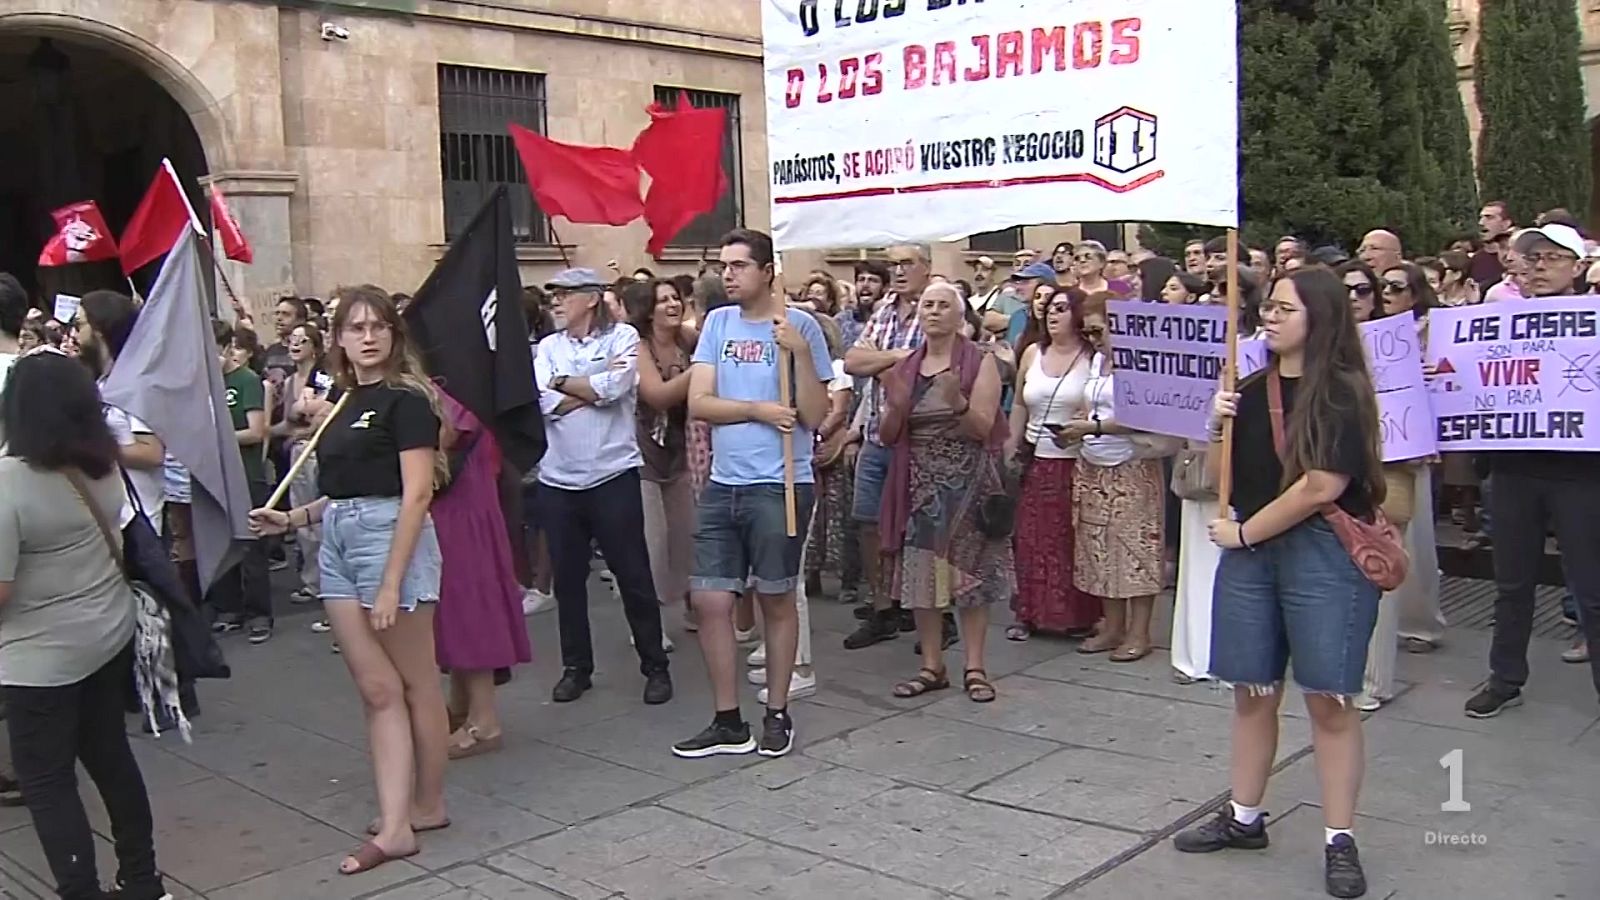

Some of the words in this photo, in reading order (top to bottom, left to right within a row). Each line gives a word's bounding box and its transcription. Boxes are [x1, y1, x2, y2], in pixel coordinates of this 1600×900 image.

[785, 68, 805, 109] O
[816, 52, 883, 104] LOS
[902, 17, 1141, 90] BAJAMOS
[773, 152, 841, 186] PARÁSITOS,
[843, 151, 860, 179] SE
[1002, 128, 1085, 165] NEGOCIO
[1185, 317, 1210, 343] DE
[1453, 315, 1501, 344] LAS
[1510, 310, 1597, 341] CASAS
[1111, 346, 1226, 381] CONSTITUCIÓN
[1487, 344, 1512, 357] SON
[1522, 339, 1556, 353] PARA
[1478, 358, 1541, 387] VIVIR
[1474, 393, 1496, 409] NO
[1507, 388, 1543, 406] PARA
[1437, 410, 1585, 442] ESPECULAR
